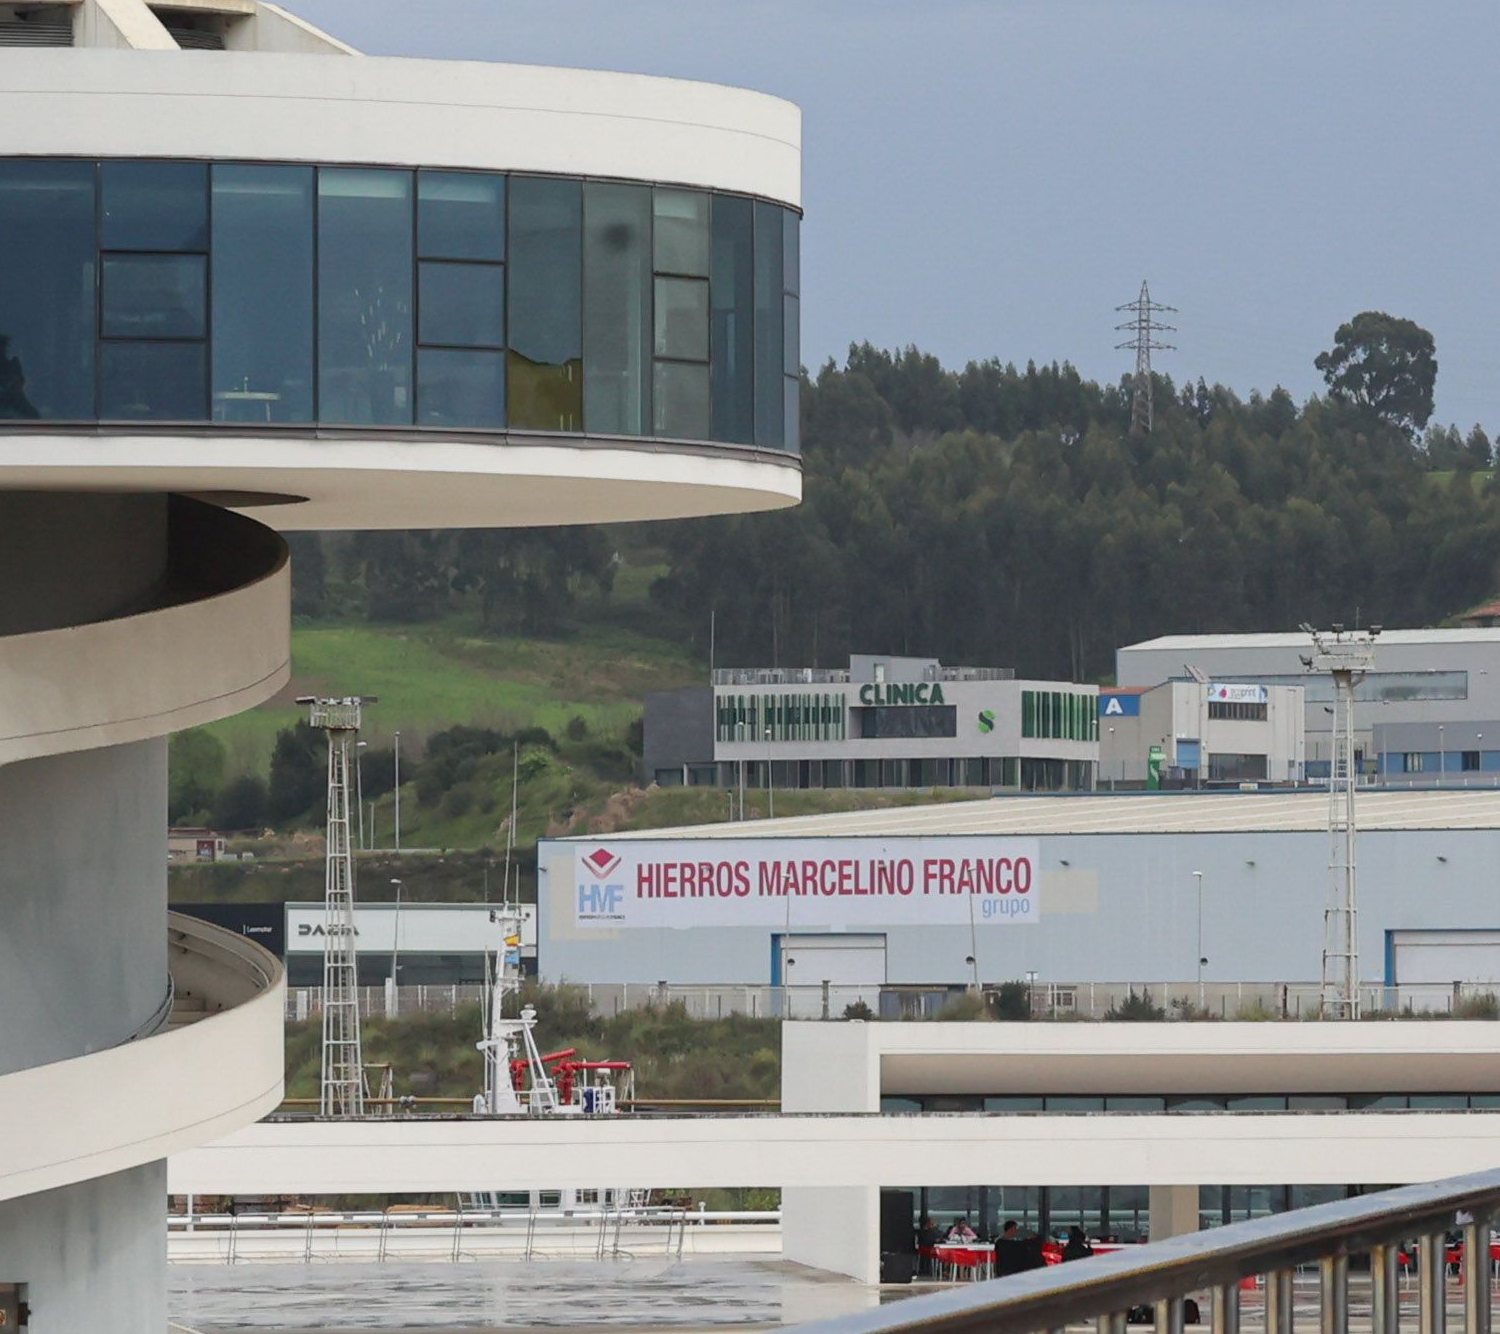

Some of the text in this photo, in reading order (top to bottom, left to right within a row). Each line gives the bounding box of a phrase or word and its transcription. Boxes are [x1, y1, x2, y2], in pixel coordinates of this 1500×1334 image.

[859, 683, 945, 706] CLINICA
[1105, 697, 1124, 715] A
[637, 857, 1032, 898] HIERROS MARCELINO FRANCO
[579, 884, 625, 913] HMF
[982, 896, 1030, 918] grupo
